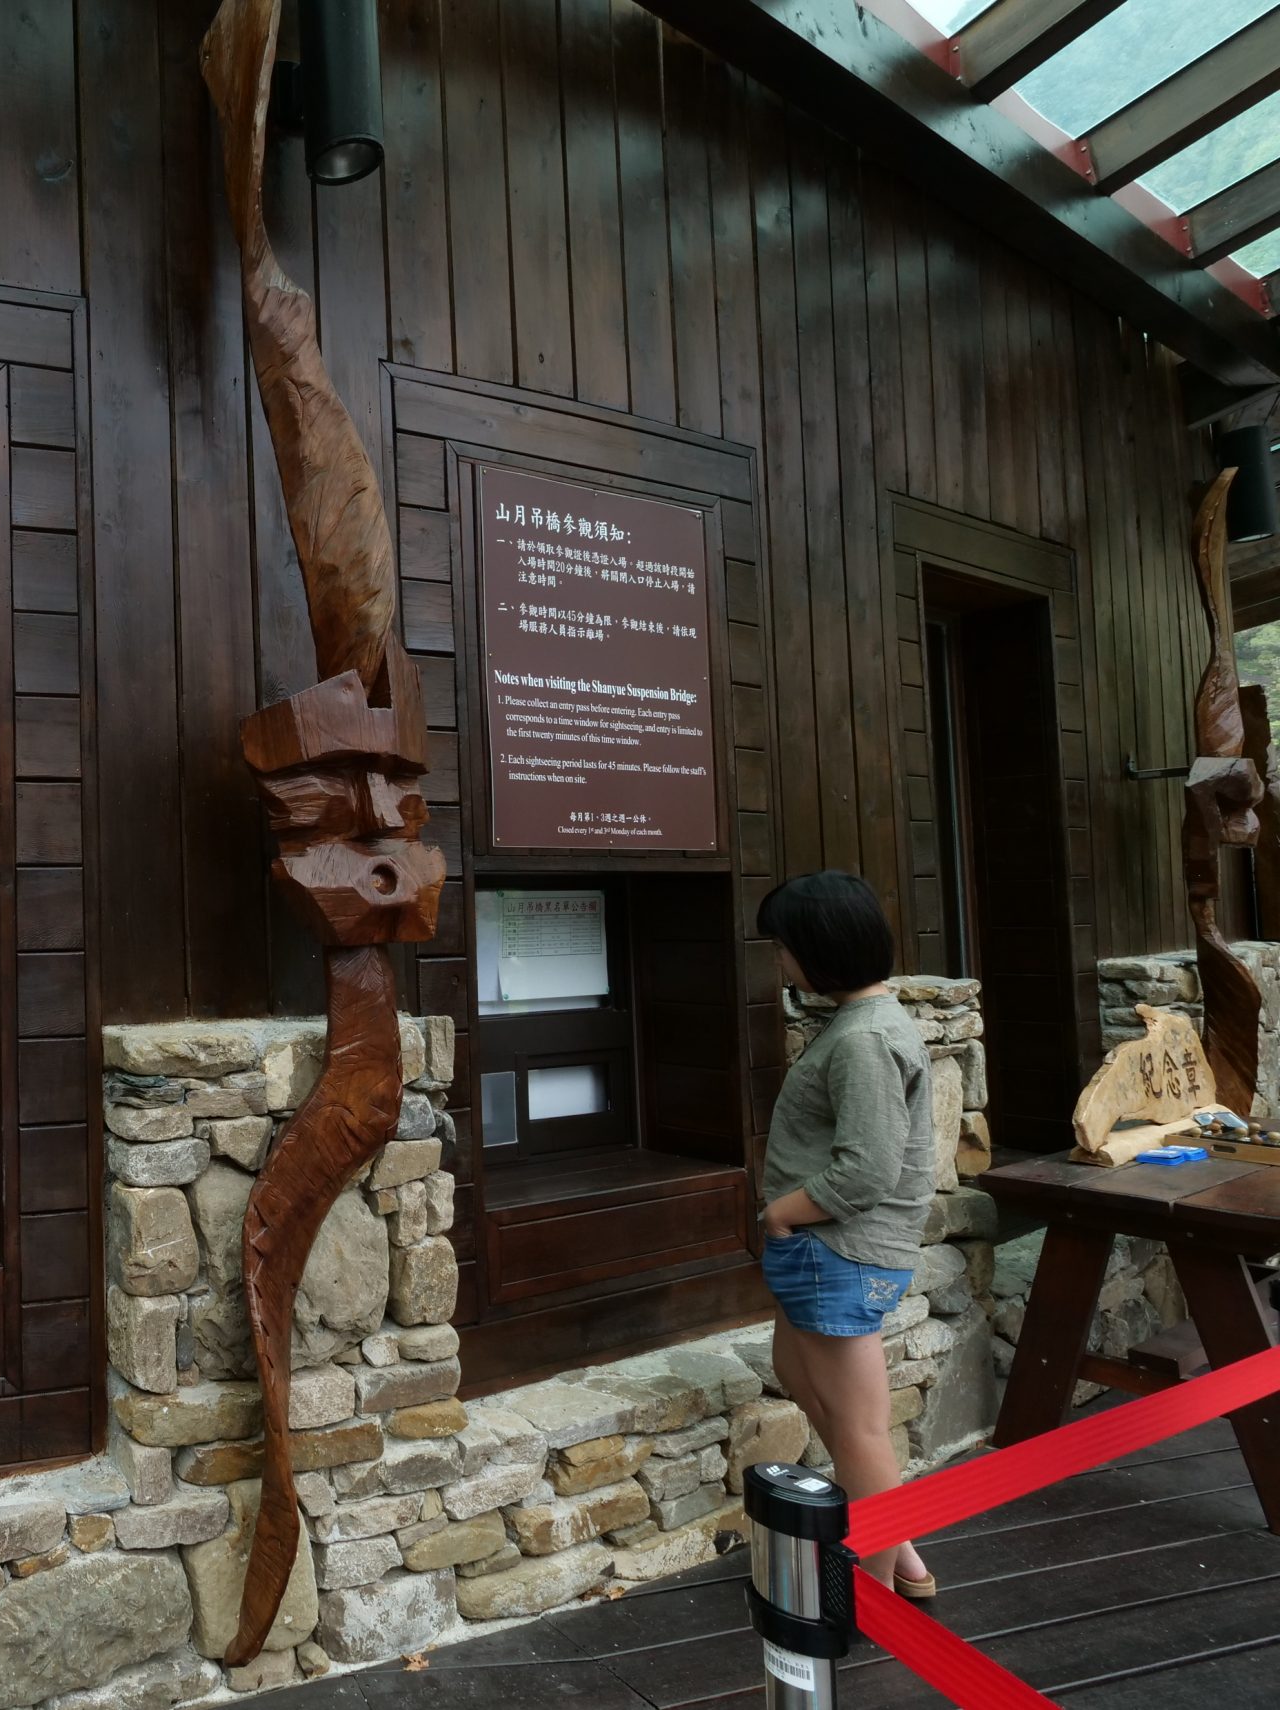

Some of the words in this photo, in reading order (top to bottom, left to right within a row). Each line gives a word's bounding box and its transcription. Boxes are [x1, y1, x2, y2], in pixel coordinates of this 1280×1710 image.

[495, 503, 632, 544] 山月吊橋參觀須知：
[494, 670, 519, 685] Notes
[521, 673, 544, 688] when
[545, 675, 577, 694] visiting
[578, 679, 591, 692] the
[591, 680, 626, 698] Shanyue
[627, 683, 669, 701] Suspension
[670, 688, 697, 706] Bridge:
[498, 695, 504, 704] 1.
[505, 695, 526, 707] Please
[527, 698, 549, 708] collect
[550, 701, 558, 709] an
[559, 702, 575, 712] entry
[576, 703, 590, 713] pass
[590, 703, 610, 714] before
[638, 707, 652, 718] Each
[653, 711, 667, 720] entry
[668, 712, 680, 721] pass
[506, 713, 545, 724] corresponds
[559, 716, 573, 726] time
[574, 717, 599, 727] window
[600, 719, 609, 728] for
[645, 724, 656, 732] and
[656, 726, 671, 735] entry
[677, 726, 697, 736] limited
[697, 729, 703, 737] to
[507, 727, 517, 737] the
[518, 728, 532, 738] first
[532, 730, 554, 741] twenty
[555, 731, 580, 741] minutes
[581, 733, 589, 742] of
[589, 733, 600, 743] this
[601, 734, 615, 744] time
[616, 736, 641, 746] window.
[500, 753, 507, 763] 2.
[508, 754, 525, 765] Each
[525, 756, 560, 769] sightseeing
[562, 758, 582, 769] period
[583, 759, 597, 769] lasts
[598, 760, 607, 769] for
[608, 761, 616, 770] 45
[617, 762, 642, 772] minutes.
[643, 763, 661, 773] Please
[662, 764, 680, 774] follow
[680, 765, 690, 775] the
[508, 770, 546, 781] instructions
[547, 773, 564, 783] when
[574, 774, 587, 784] site.
[558, 825, 574, 834] Closed
[610, 828, 630, 836] Monday
[1139, 1049, 1200, 1100] 紀念章
